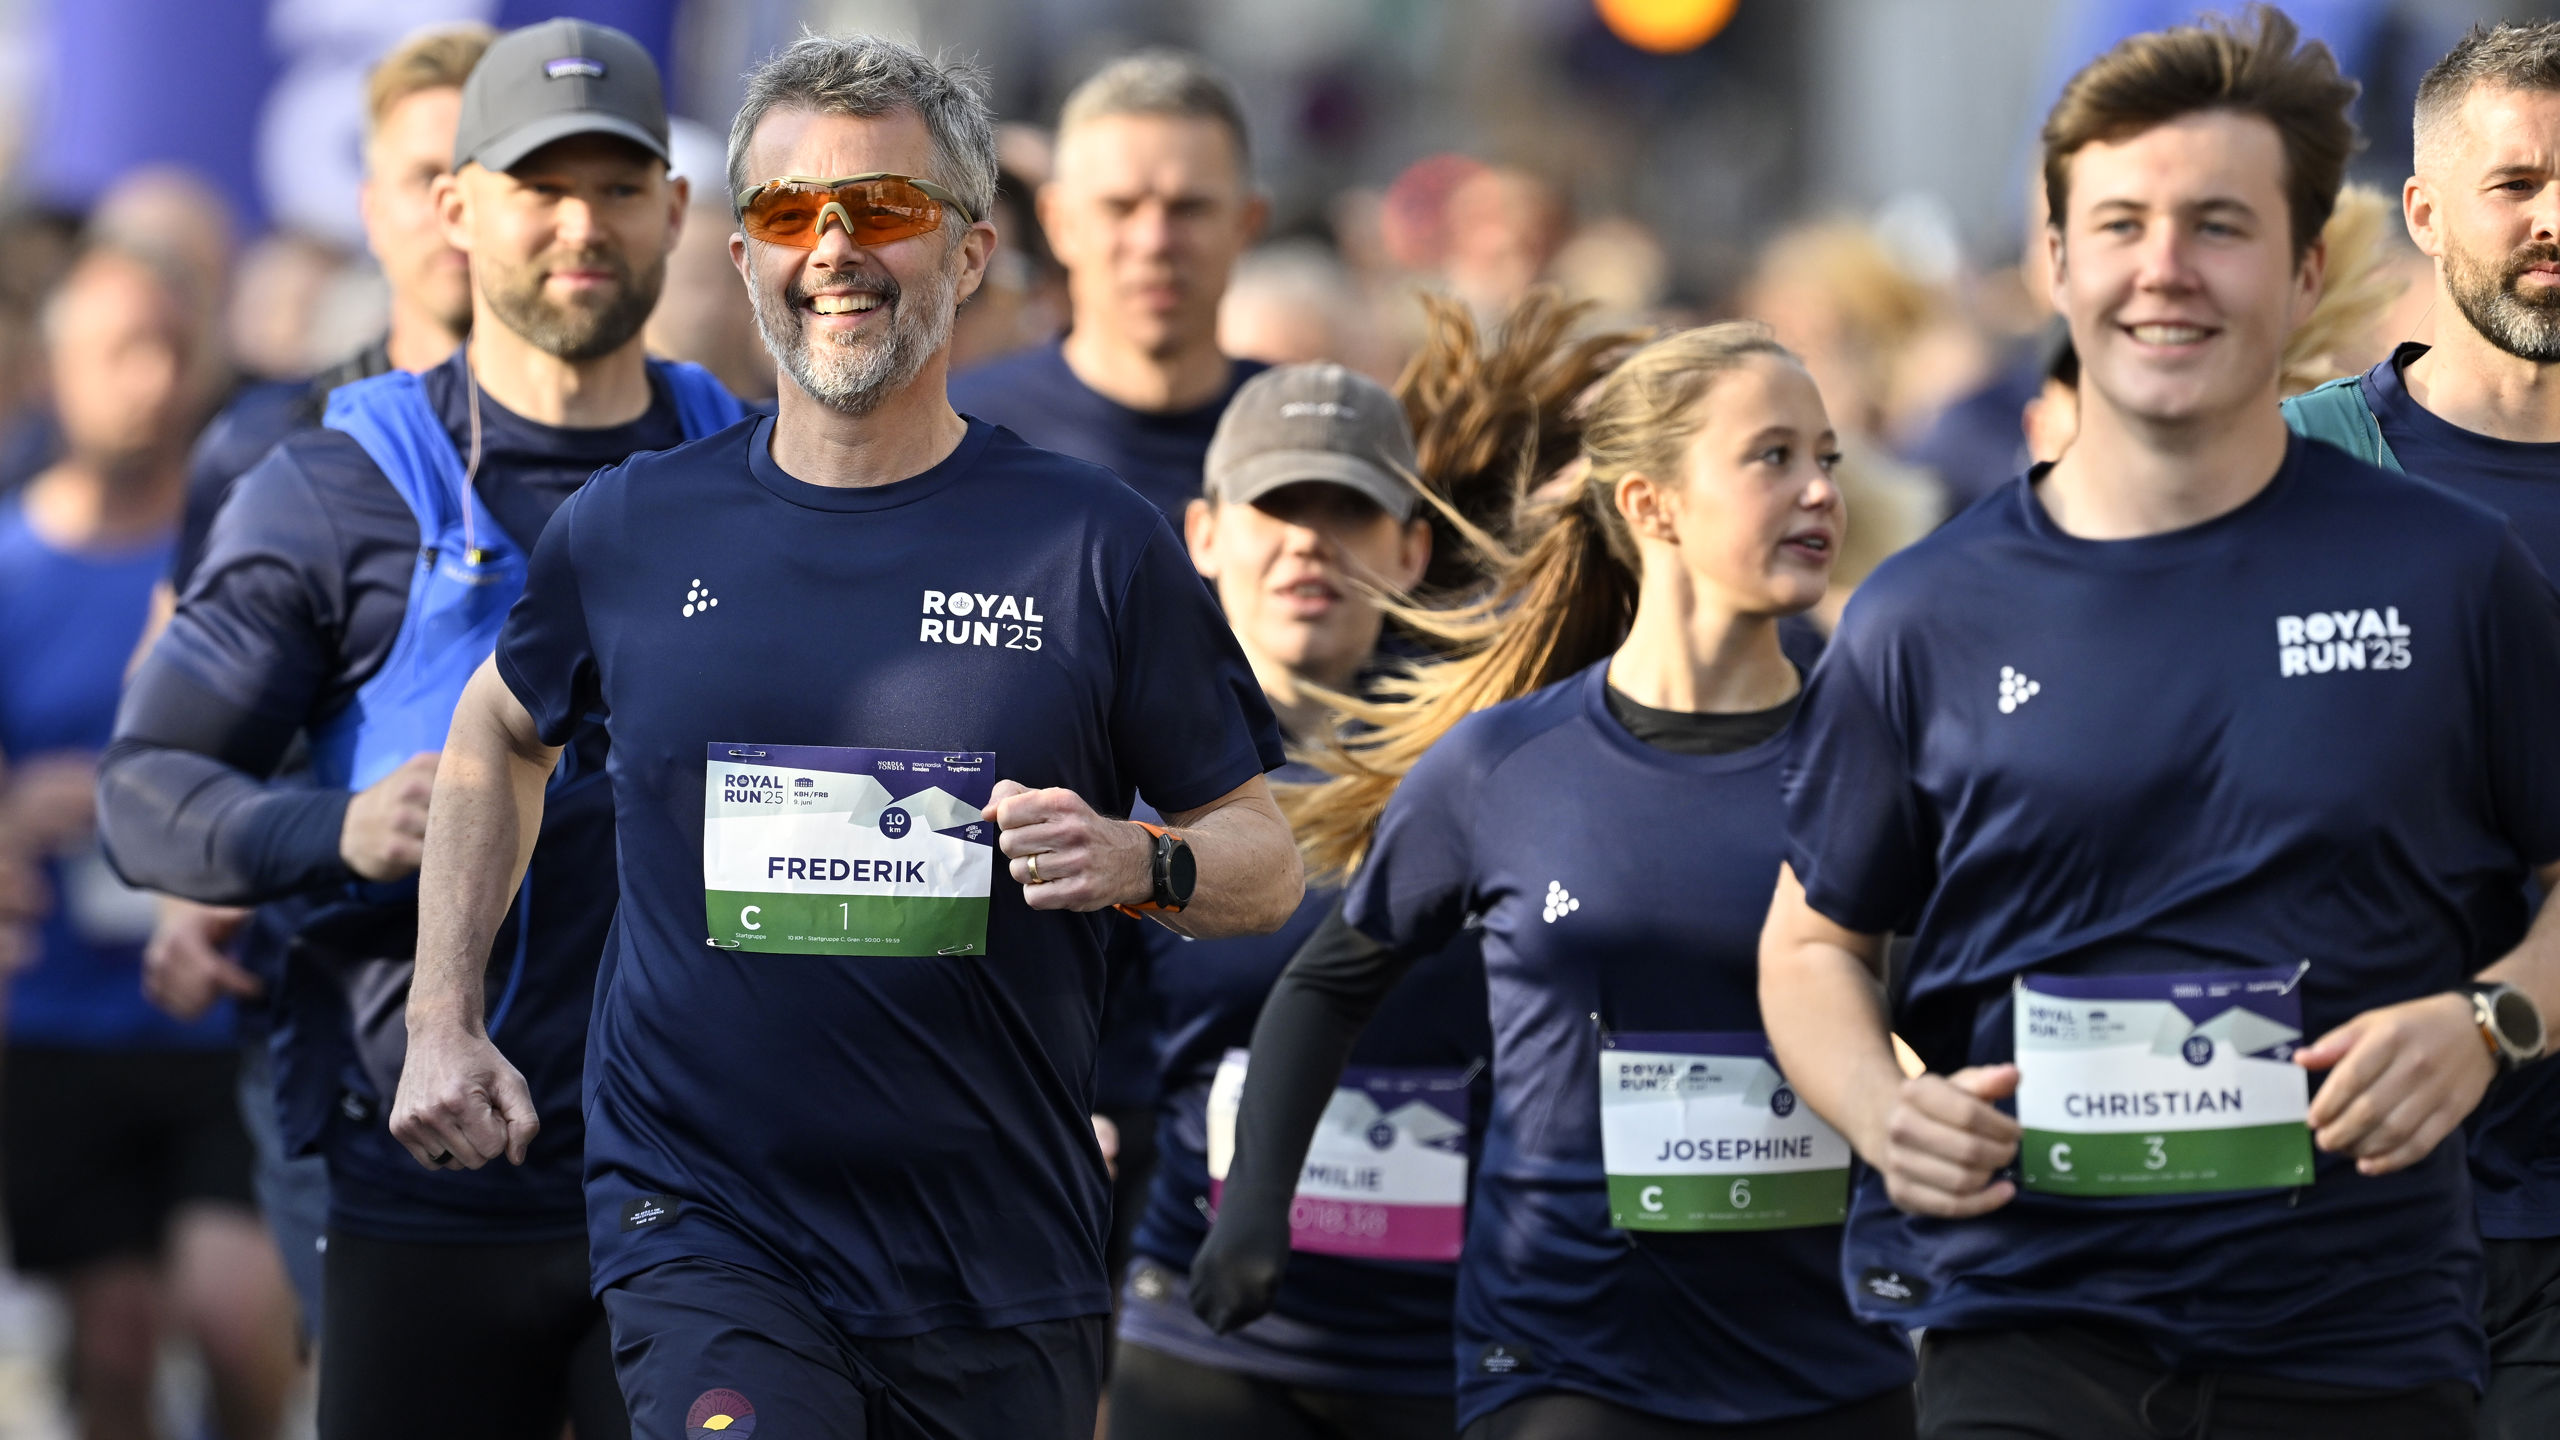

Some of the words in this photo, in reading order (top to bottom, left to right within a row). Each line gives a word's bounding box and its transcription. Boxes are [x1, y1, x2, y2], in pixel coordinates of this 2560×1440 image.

[923, 590, 1043, 622] ROYAL
[2276, 605, 2411, 646] ROYAL
[725, 774, 783, 788] ROYAL
[886, 814, 905, 825] 10
[768, 856, 926, 883] FREDERIK
[740, 905, 761, 931] C
[839, 902, 849, 931] 1
[2064, 1087, 2243, 1118] CHRISTIAN
[1656, 1135, 1813, 1161] JOSEPHINE
[2049, 1142, 2073, 1172] C
[2143, 1136, 2167, 1170] 3
[1639, 1185, 1664, 1212] C
[1729, 1178, 1751, 1209] 6
